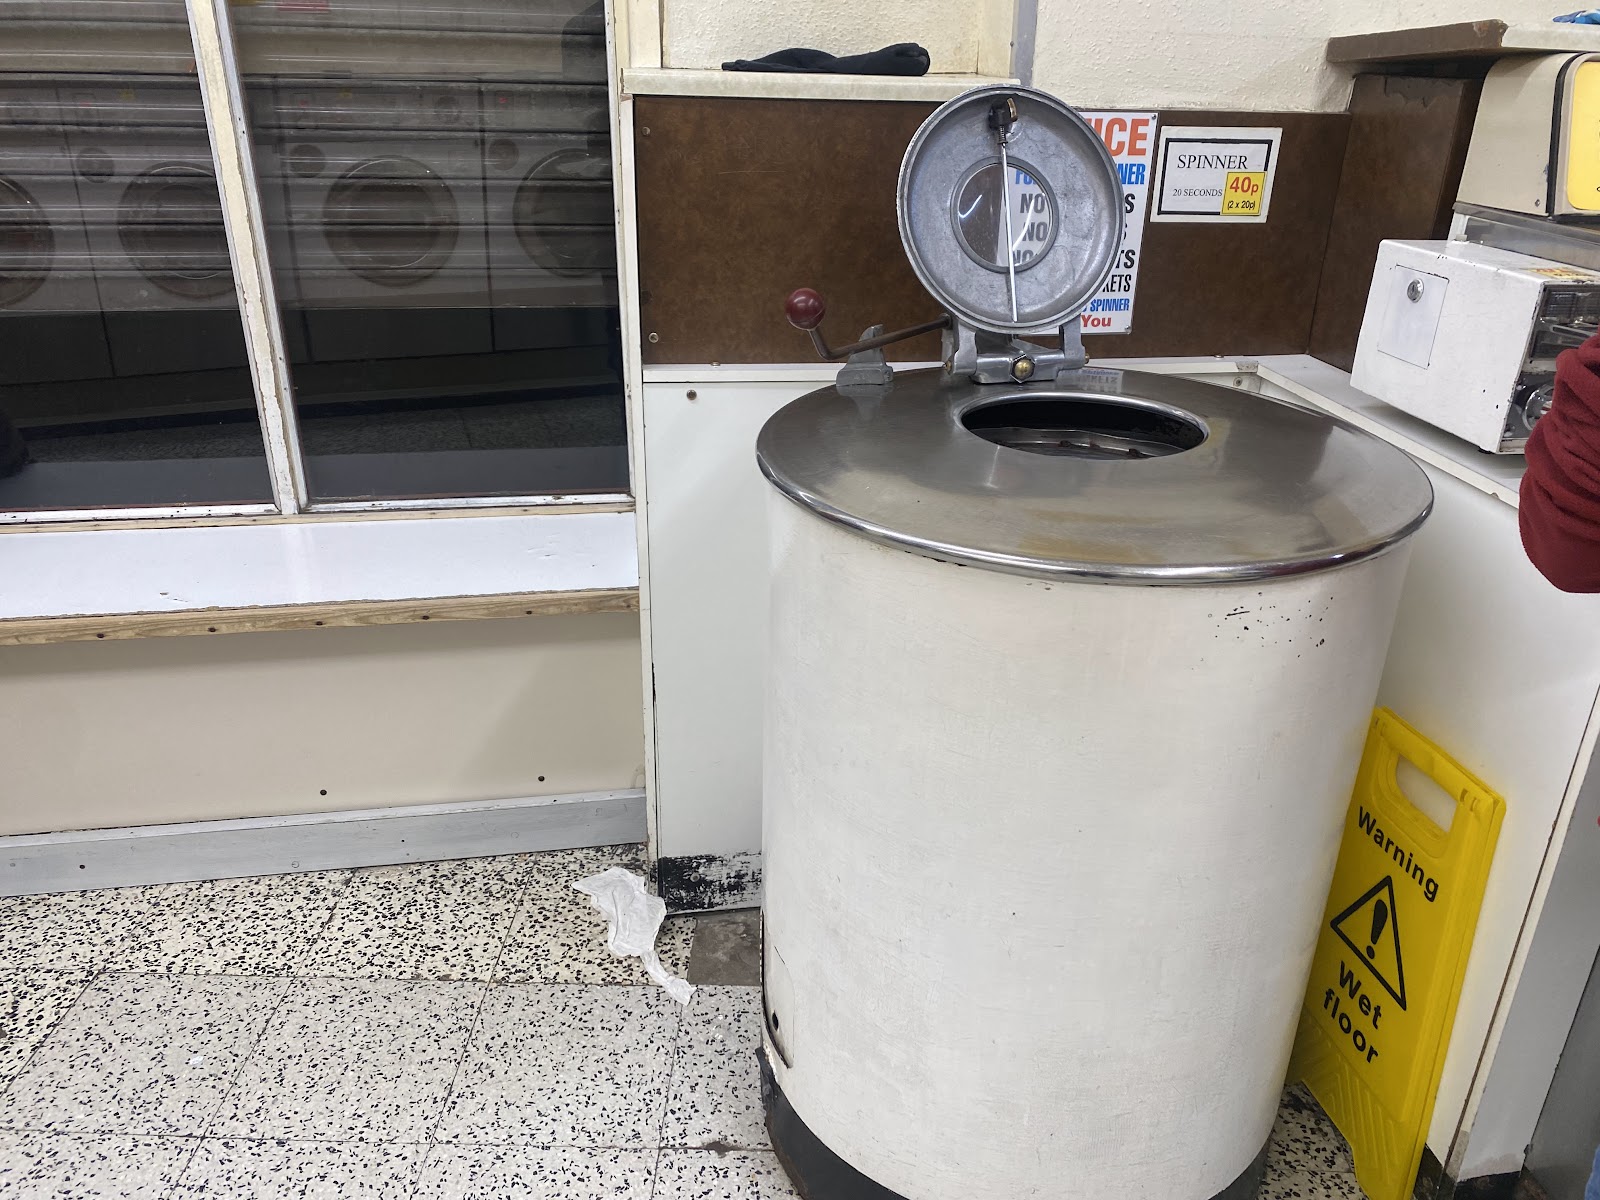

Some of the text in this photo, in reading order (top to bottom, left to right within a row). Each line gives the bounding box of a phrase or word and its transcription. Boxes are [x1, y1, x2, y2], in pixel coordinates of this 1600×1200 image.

[1177, 154, 1248, 170] SPINNER
[1172, 188, 1223, 197] 20 SECONDS
[1229, 176, 1259, 196] 40p
[1020, 193, 1046, 214] NO
[1227, 200, 1234, 210] (2
[1241, 200, 1256, 210] 20p)
[1022, 221, 1048, 241] NO
[1090, 298, 1130, 312] SPINNER
[1080, 314, 1112, 328] You
[1358, 805, 1439, 903] Warning
[1339, 960, 1382, 1030] Wet
[1323, 988, 1379, 1063] floor
